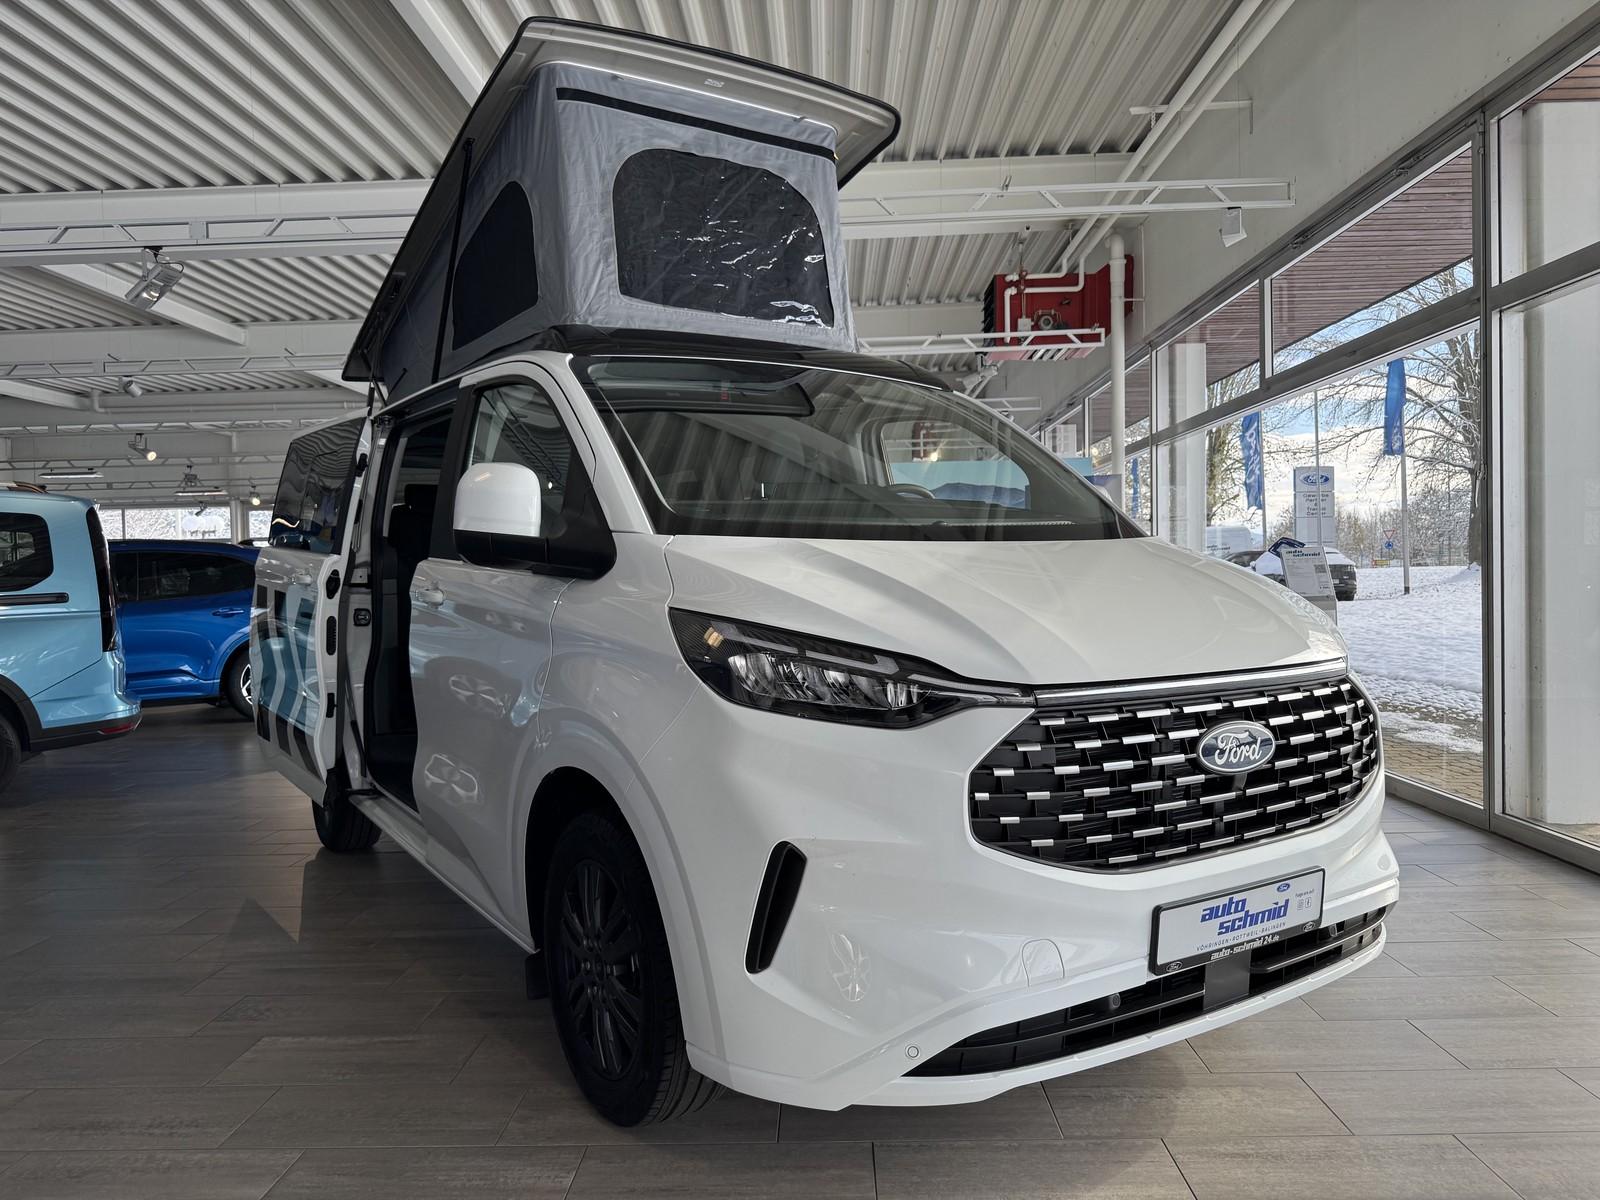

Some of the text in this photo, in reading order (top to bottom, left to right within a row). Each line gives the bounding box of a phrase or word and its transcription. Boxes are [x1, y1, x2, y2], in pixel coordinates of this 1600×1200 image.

[1214, 731, 1263, 766] Ford
[1200, 896, 1247, 923] auto
[1217, 898, 1290, 936] schmid
